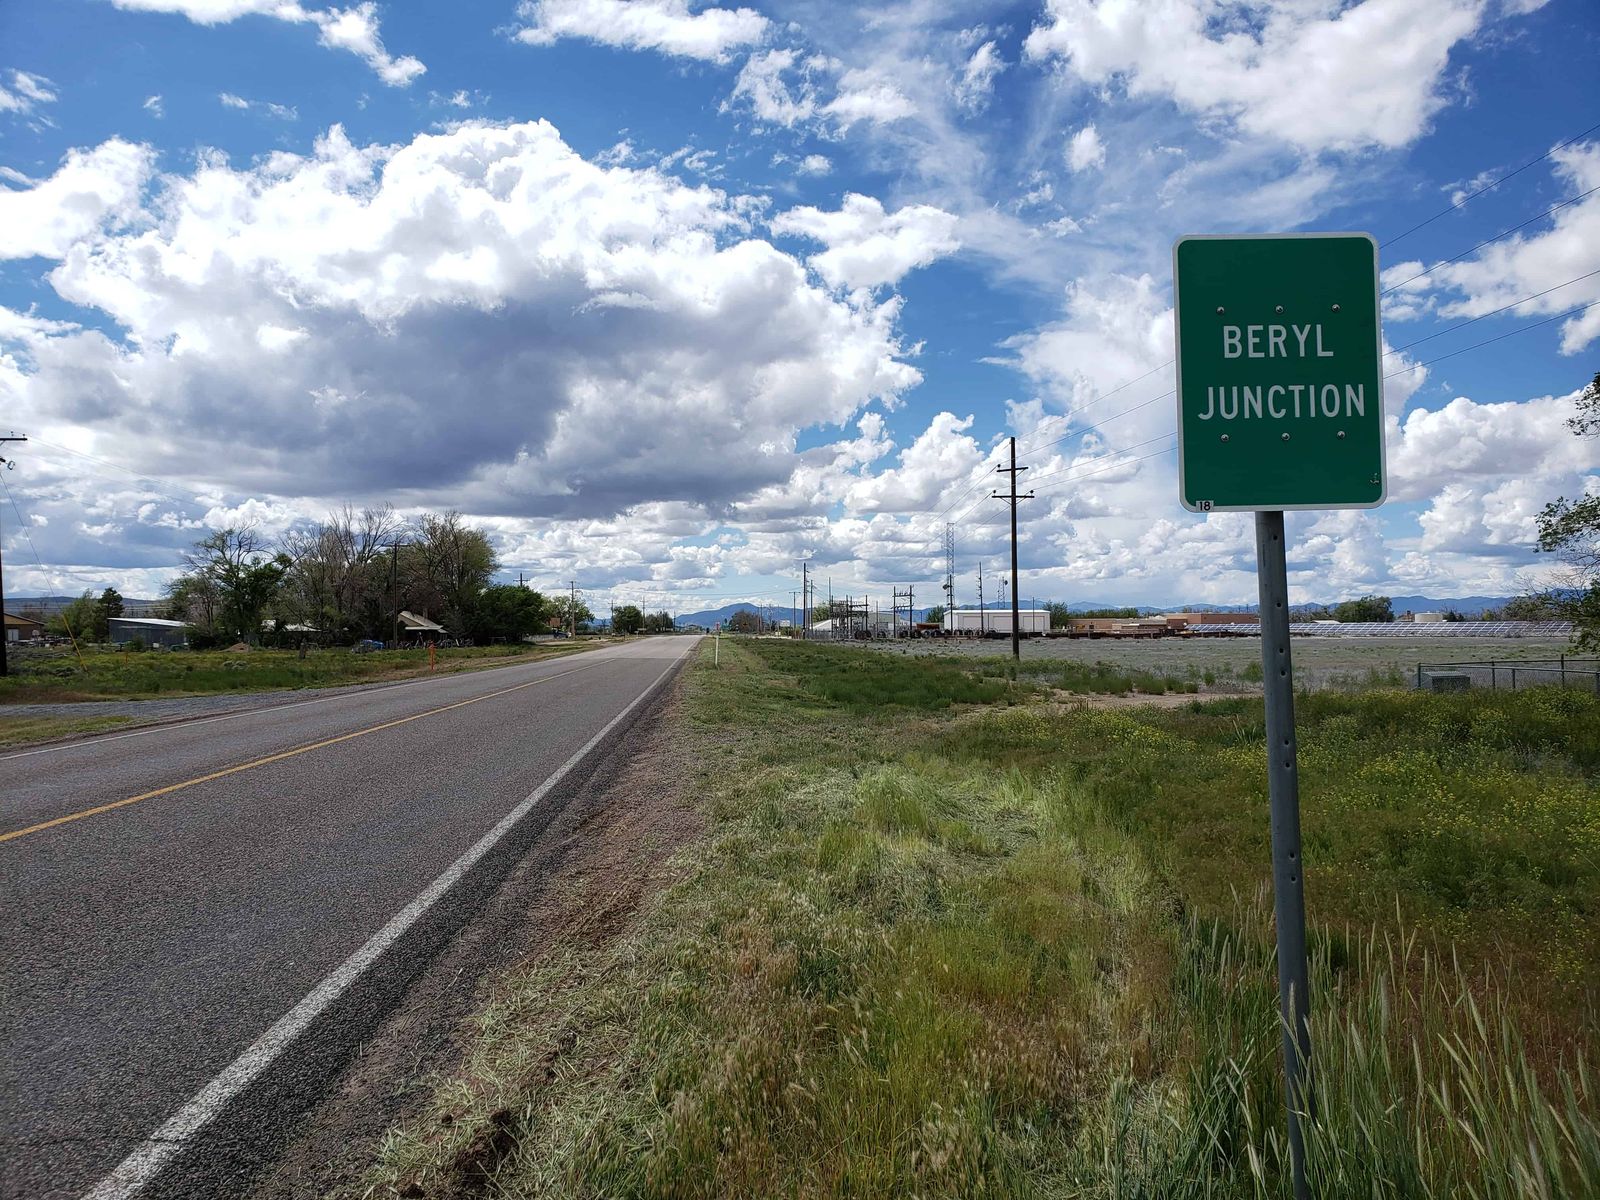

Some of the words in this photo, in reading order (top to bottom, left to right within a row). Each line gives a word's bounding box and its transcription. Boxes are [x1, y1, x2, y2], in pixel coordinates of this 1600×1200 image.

[1223, 324, 1334, 358] BERYL
[1198, 384, 1365, 420] JUNCTION
[1199, 501, 1211, 511] 18
